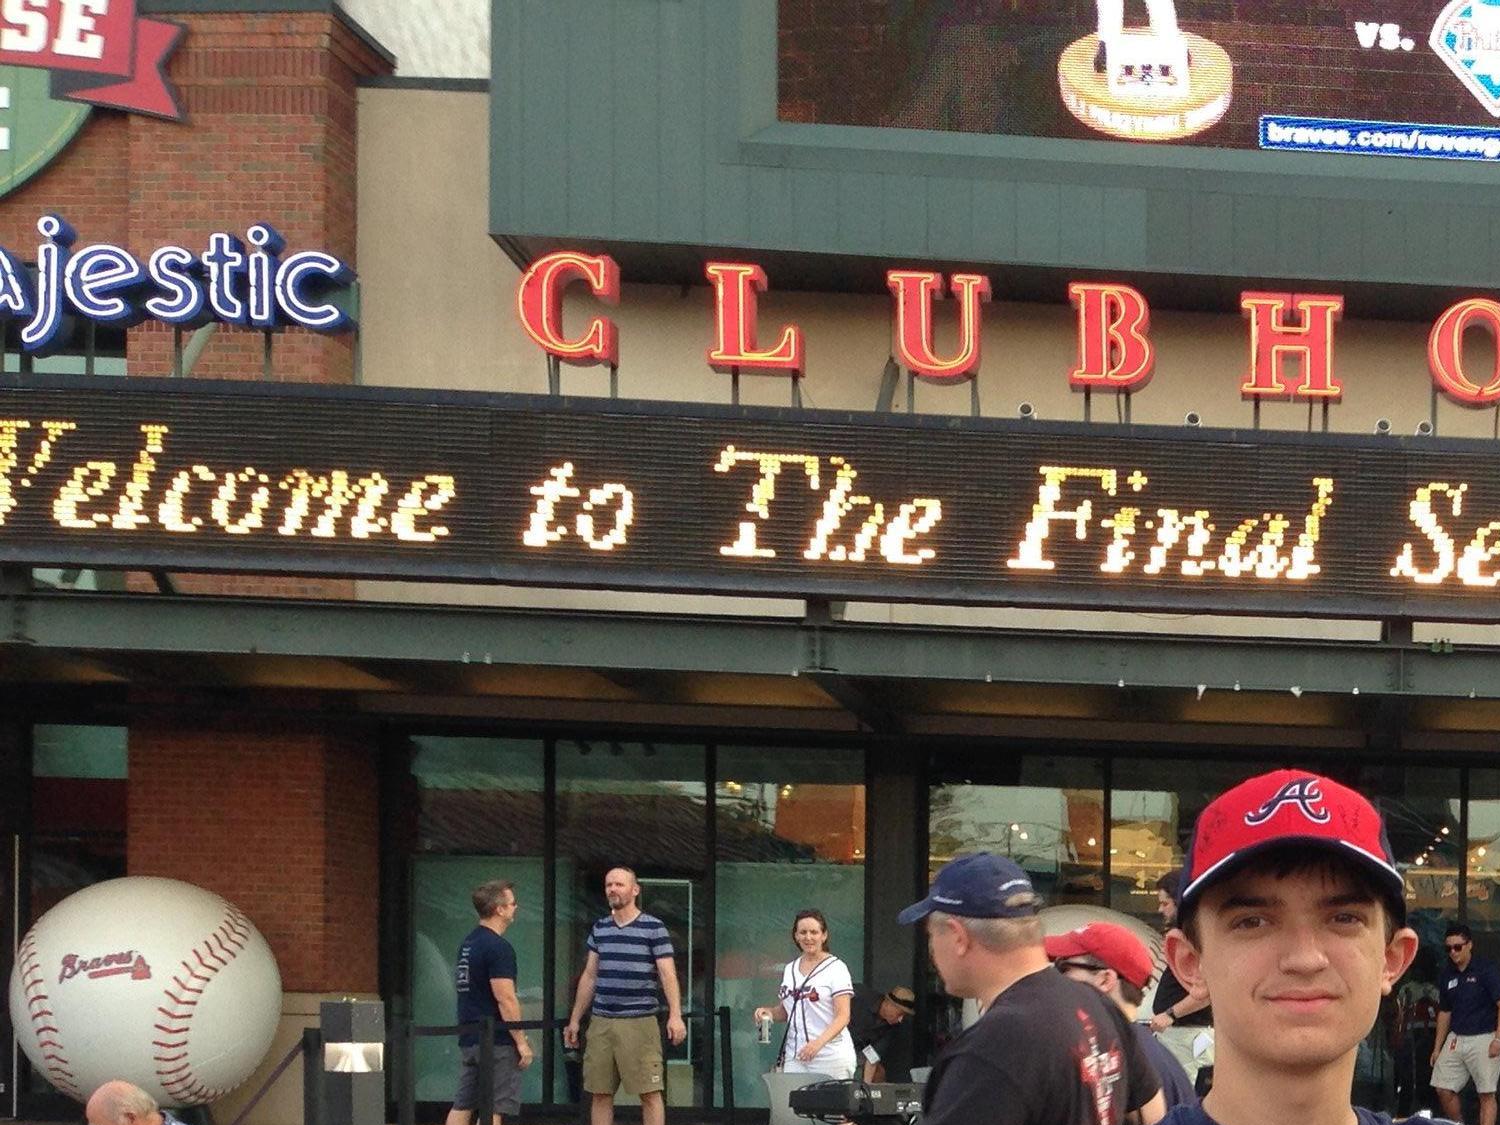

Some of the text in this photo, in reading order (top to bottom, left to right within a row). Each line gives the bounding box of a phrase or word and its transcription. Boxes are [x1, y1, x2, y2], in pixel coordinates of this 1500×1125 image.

[1355, 22, 1415, 50] vs.
[522, 461, 634, 551] to
[715, 445, 941, 564] The
[1007, 465, 1333, 580] Final
